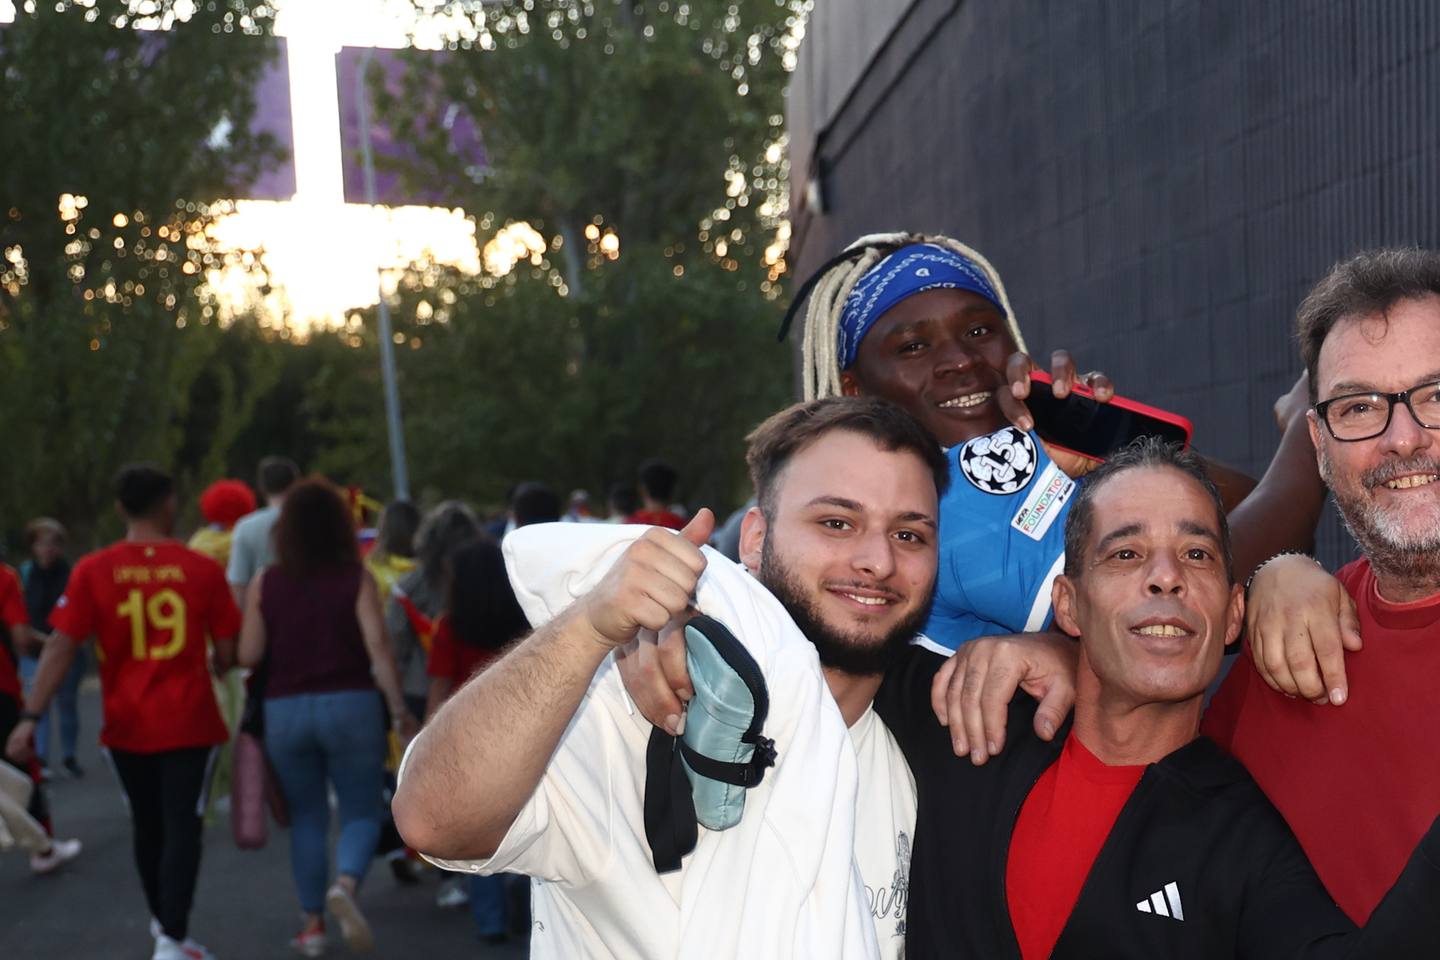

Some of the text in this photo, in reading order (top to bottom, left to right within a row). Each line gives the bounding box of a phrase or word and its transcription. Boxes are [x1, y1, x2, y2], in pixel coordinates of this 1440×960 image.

[981, 438, 1016, 478] 15
[1015, 508, 1028, 525] UEFA
[1023, 473, 1066, 532] FOUNDATION
[116, 588, 186, 660] 19
